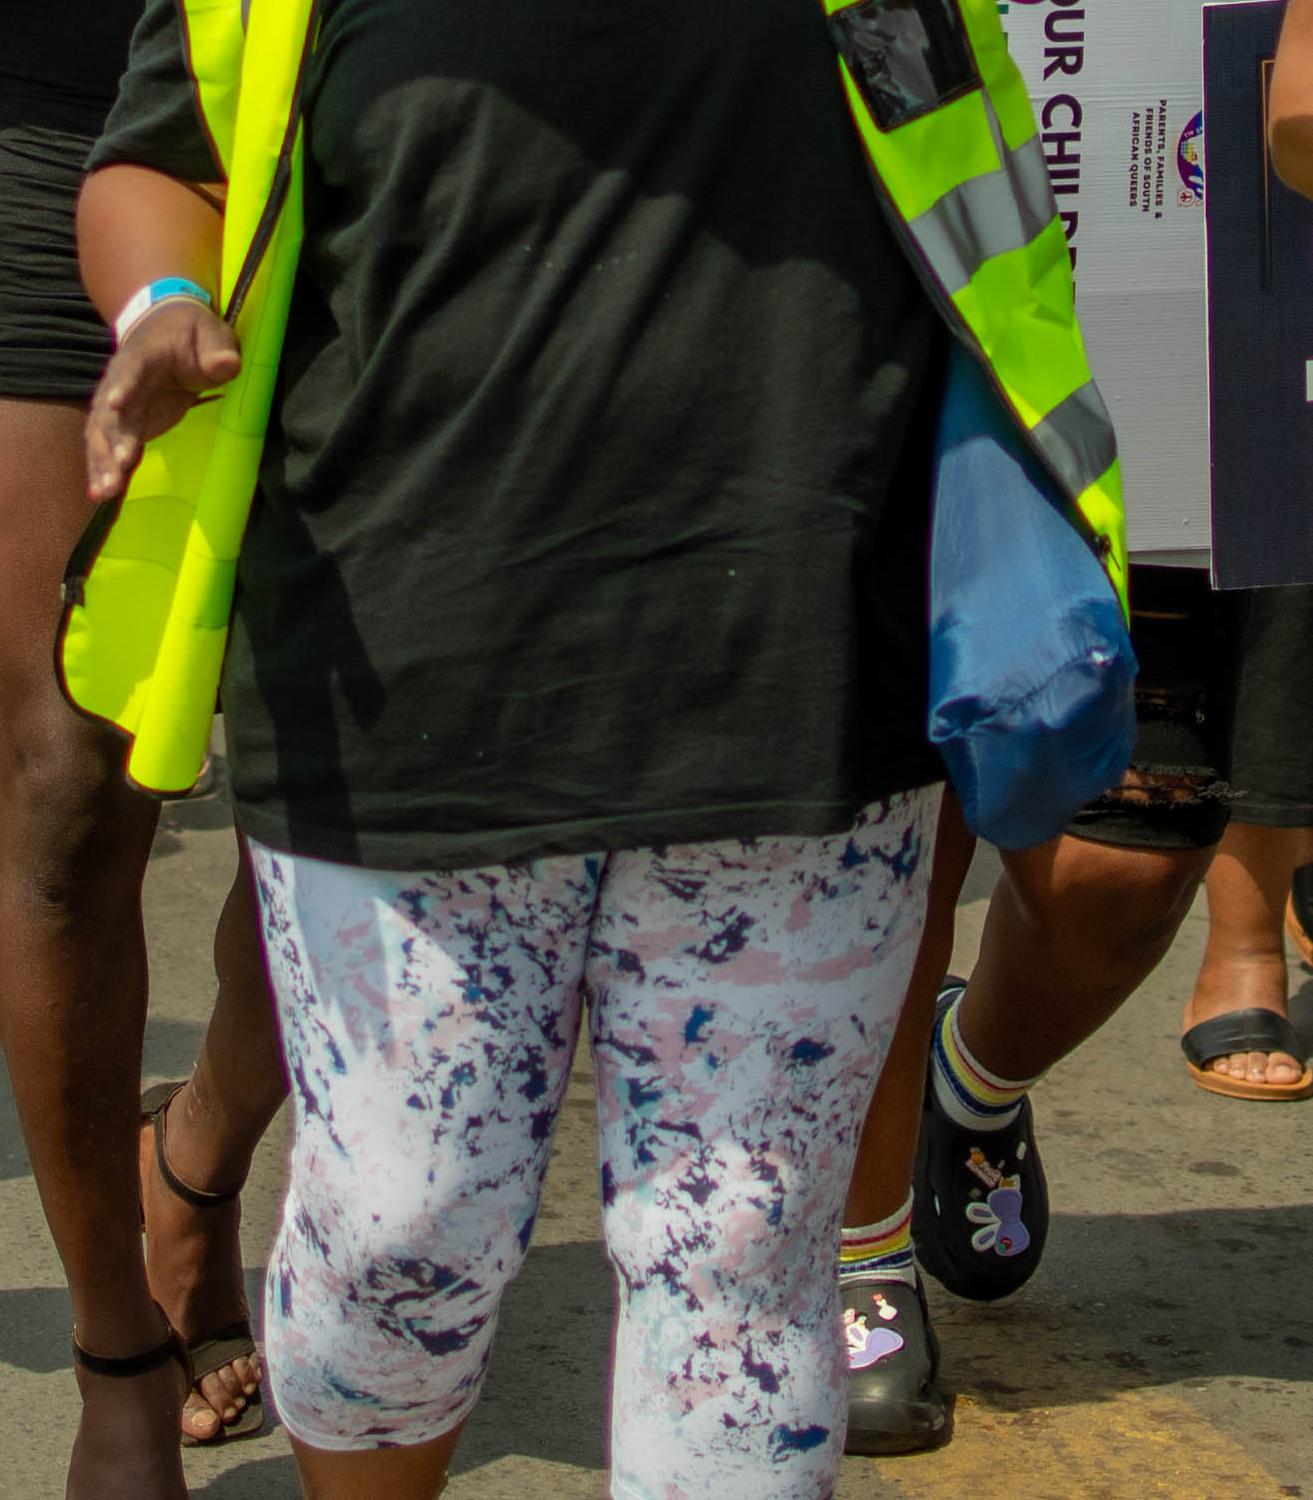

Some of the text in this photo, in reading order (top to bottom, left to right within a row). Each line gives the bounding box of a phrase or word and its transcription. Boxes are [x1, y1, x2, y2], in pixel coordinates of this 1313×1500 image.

[1129, 111, 1140, 207] AFRICAN QUEERS
[1142, 108, 1154, 212] FRIENDS OF SOUTH
[1156, 100, 1167, 153] PARENTS,
[1155, 156, 1165, 206] FAMILIES
